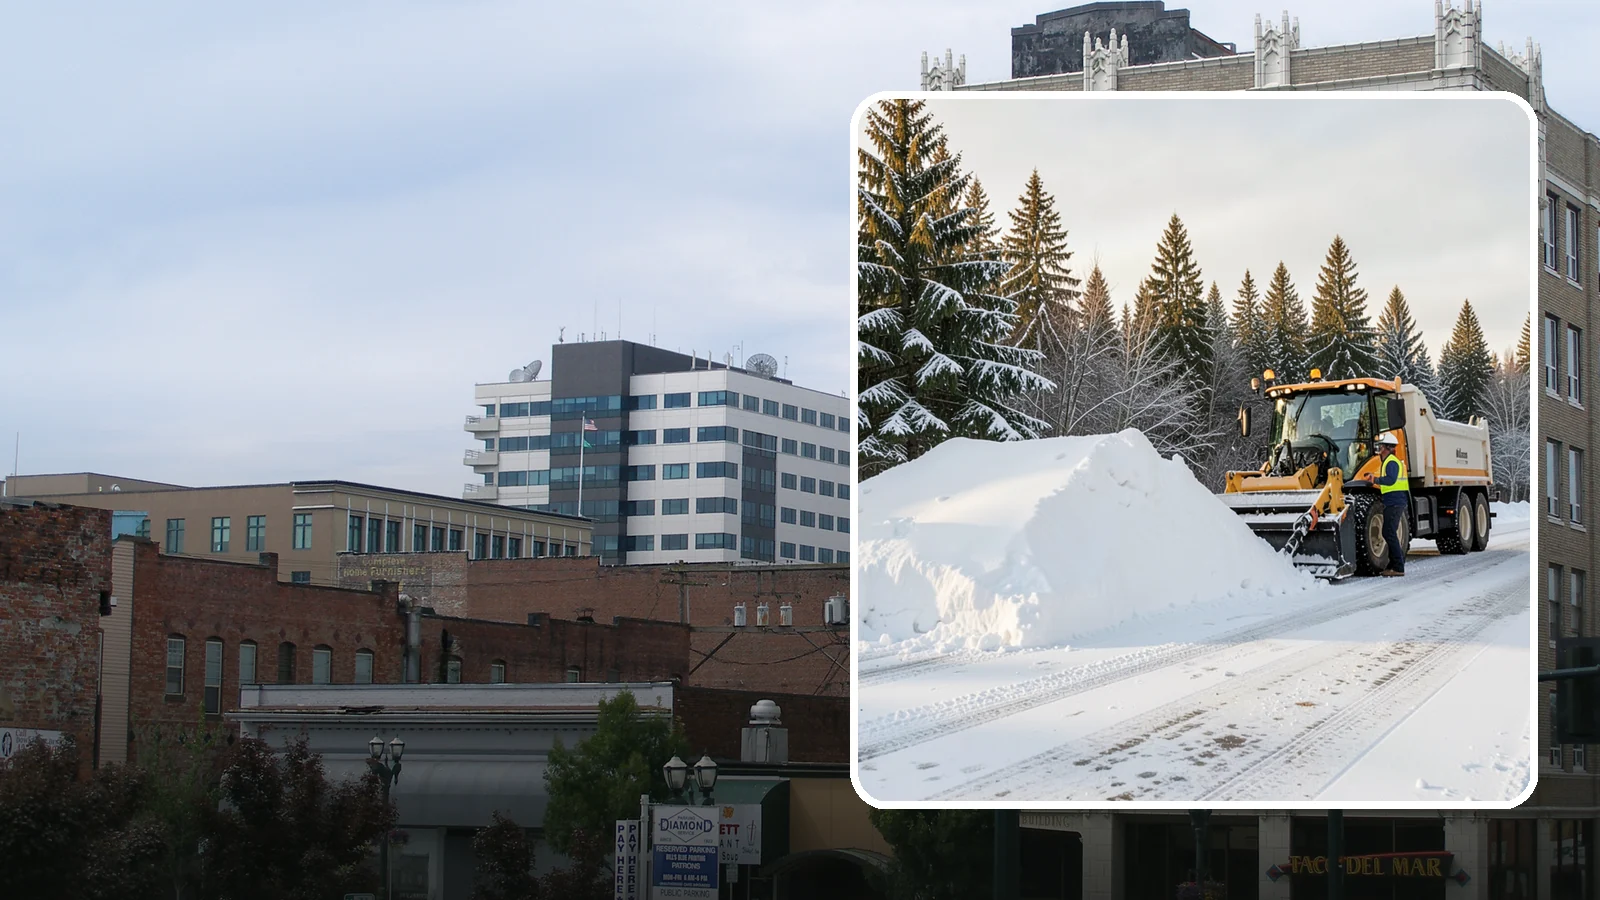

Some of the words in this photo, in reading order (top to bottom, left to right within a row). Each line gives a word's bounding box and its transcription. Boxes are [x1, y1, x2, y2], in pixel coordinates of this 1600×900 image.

[362, 557, 406, 567] Complete
[343, 567, 368, 577] Home
[370, 566, 427, 577] Furnishers
[660, 818, 713, 833] DIAMOND
[1021, 815, 1071, 828] BUILDING
[656, 845, 688, 853] RESERVED
[689, 846, 716, 854] PARKING
[721, 851, 739, 862] Soup
[1345, 856, 1385, 875] DEL
[1391, 857, 1442, 877] MAR
[628, 856, 636, 893] HERE
[660, 888, 682, 897] PUBLIC
[684, 889, 710, 898] PARKING
